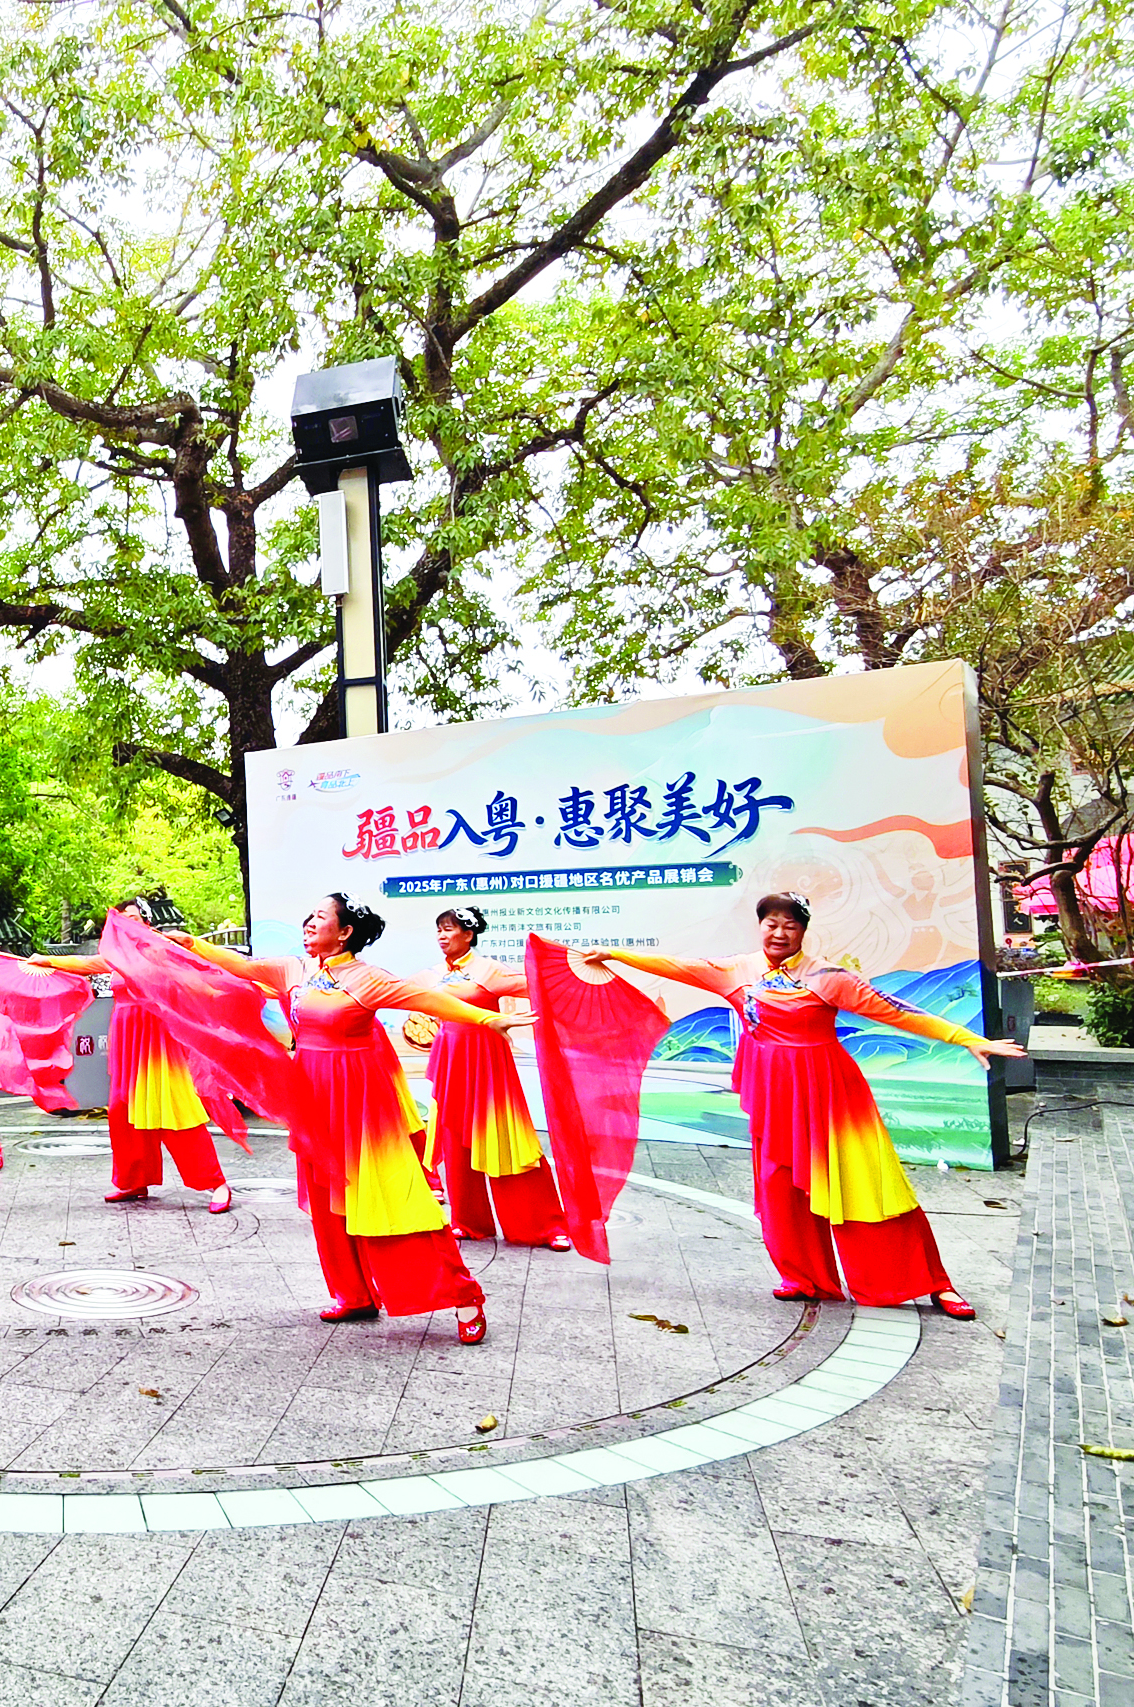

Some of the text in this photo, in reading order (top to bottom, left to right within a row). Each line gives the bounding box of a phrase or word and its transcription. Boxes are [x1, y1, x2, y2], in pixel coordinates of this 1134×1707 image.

[342, 772, 795, 859] 疆品入粤·惠聚美好
